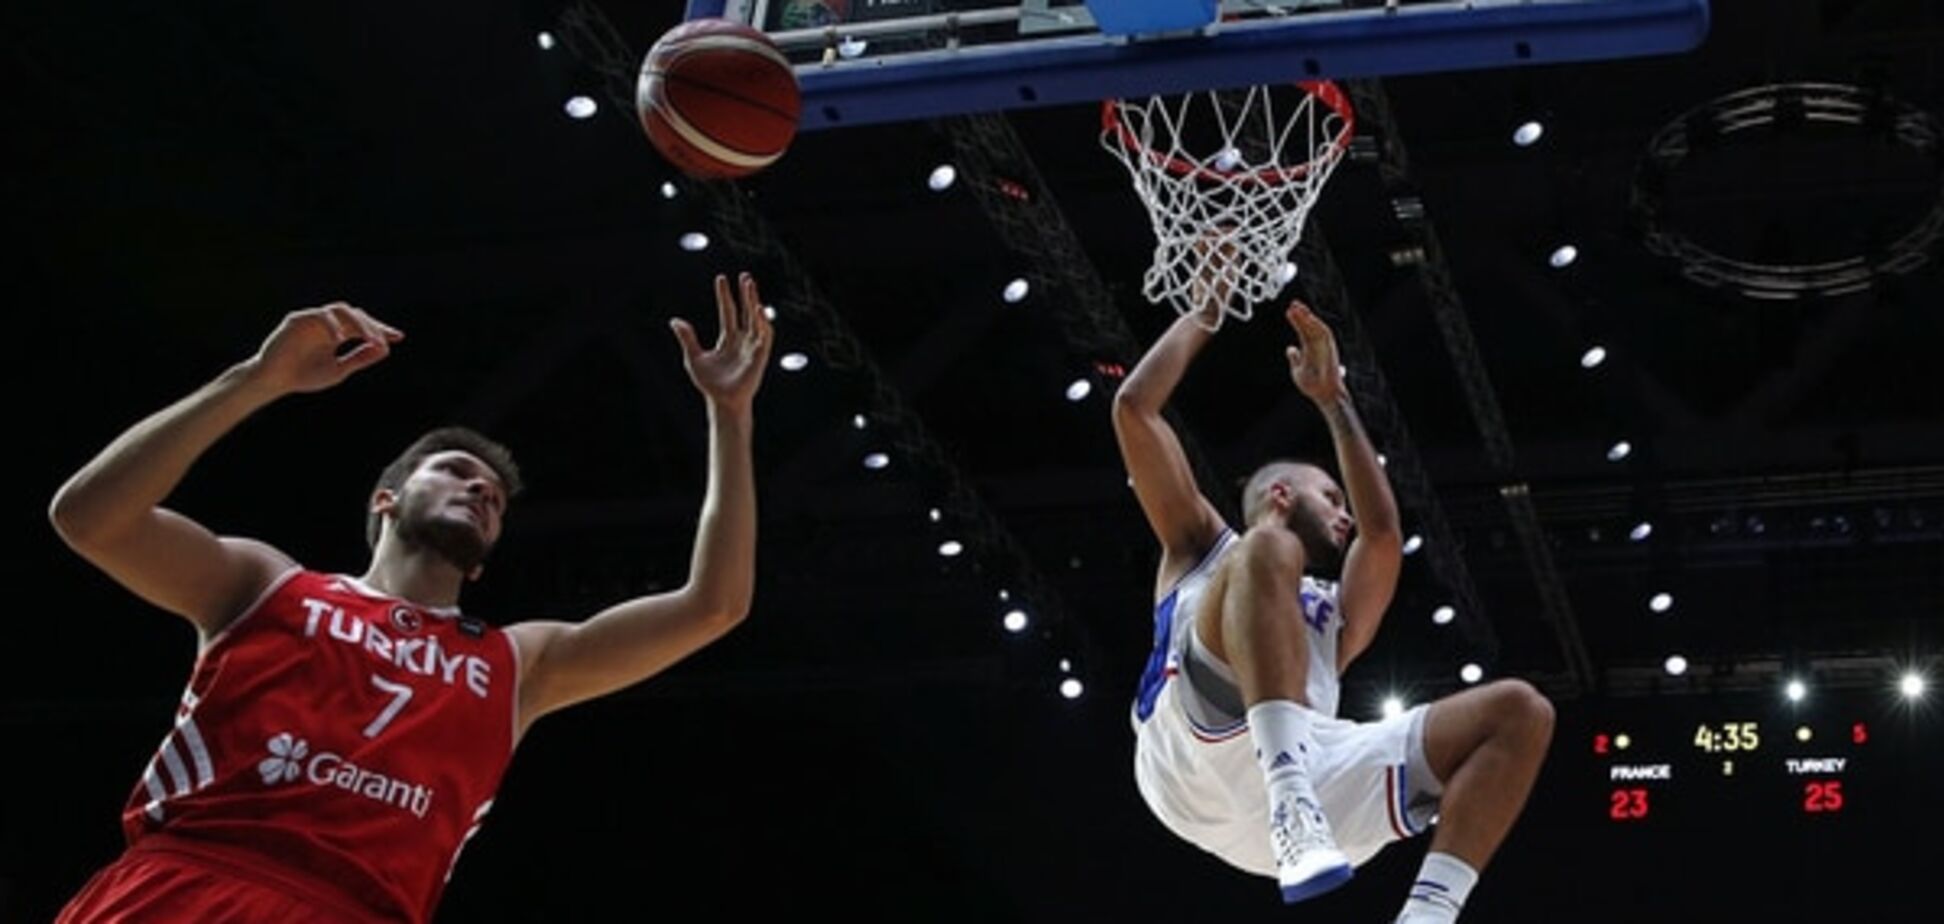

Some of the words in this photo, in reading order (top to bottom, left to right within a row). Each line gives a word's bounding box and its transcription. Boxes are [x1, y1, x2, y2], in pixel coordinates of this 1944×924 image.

[363, 674, 414, 739] 7
[1594, 735, 1608, 753] 2
[1694, 722, 1759, 752] 4:35
[1853, 725, 1867, 743] 5
[1611, 764, 1671, 780] FRANCE
[1786, 758, 1846, 774] TURKEY
[307, 752, 433, 818] Garanti
[1804, 782, 1843, 811] 25
[1611, 789, 1648, 819] 23
